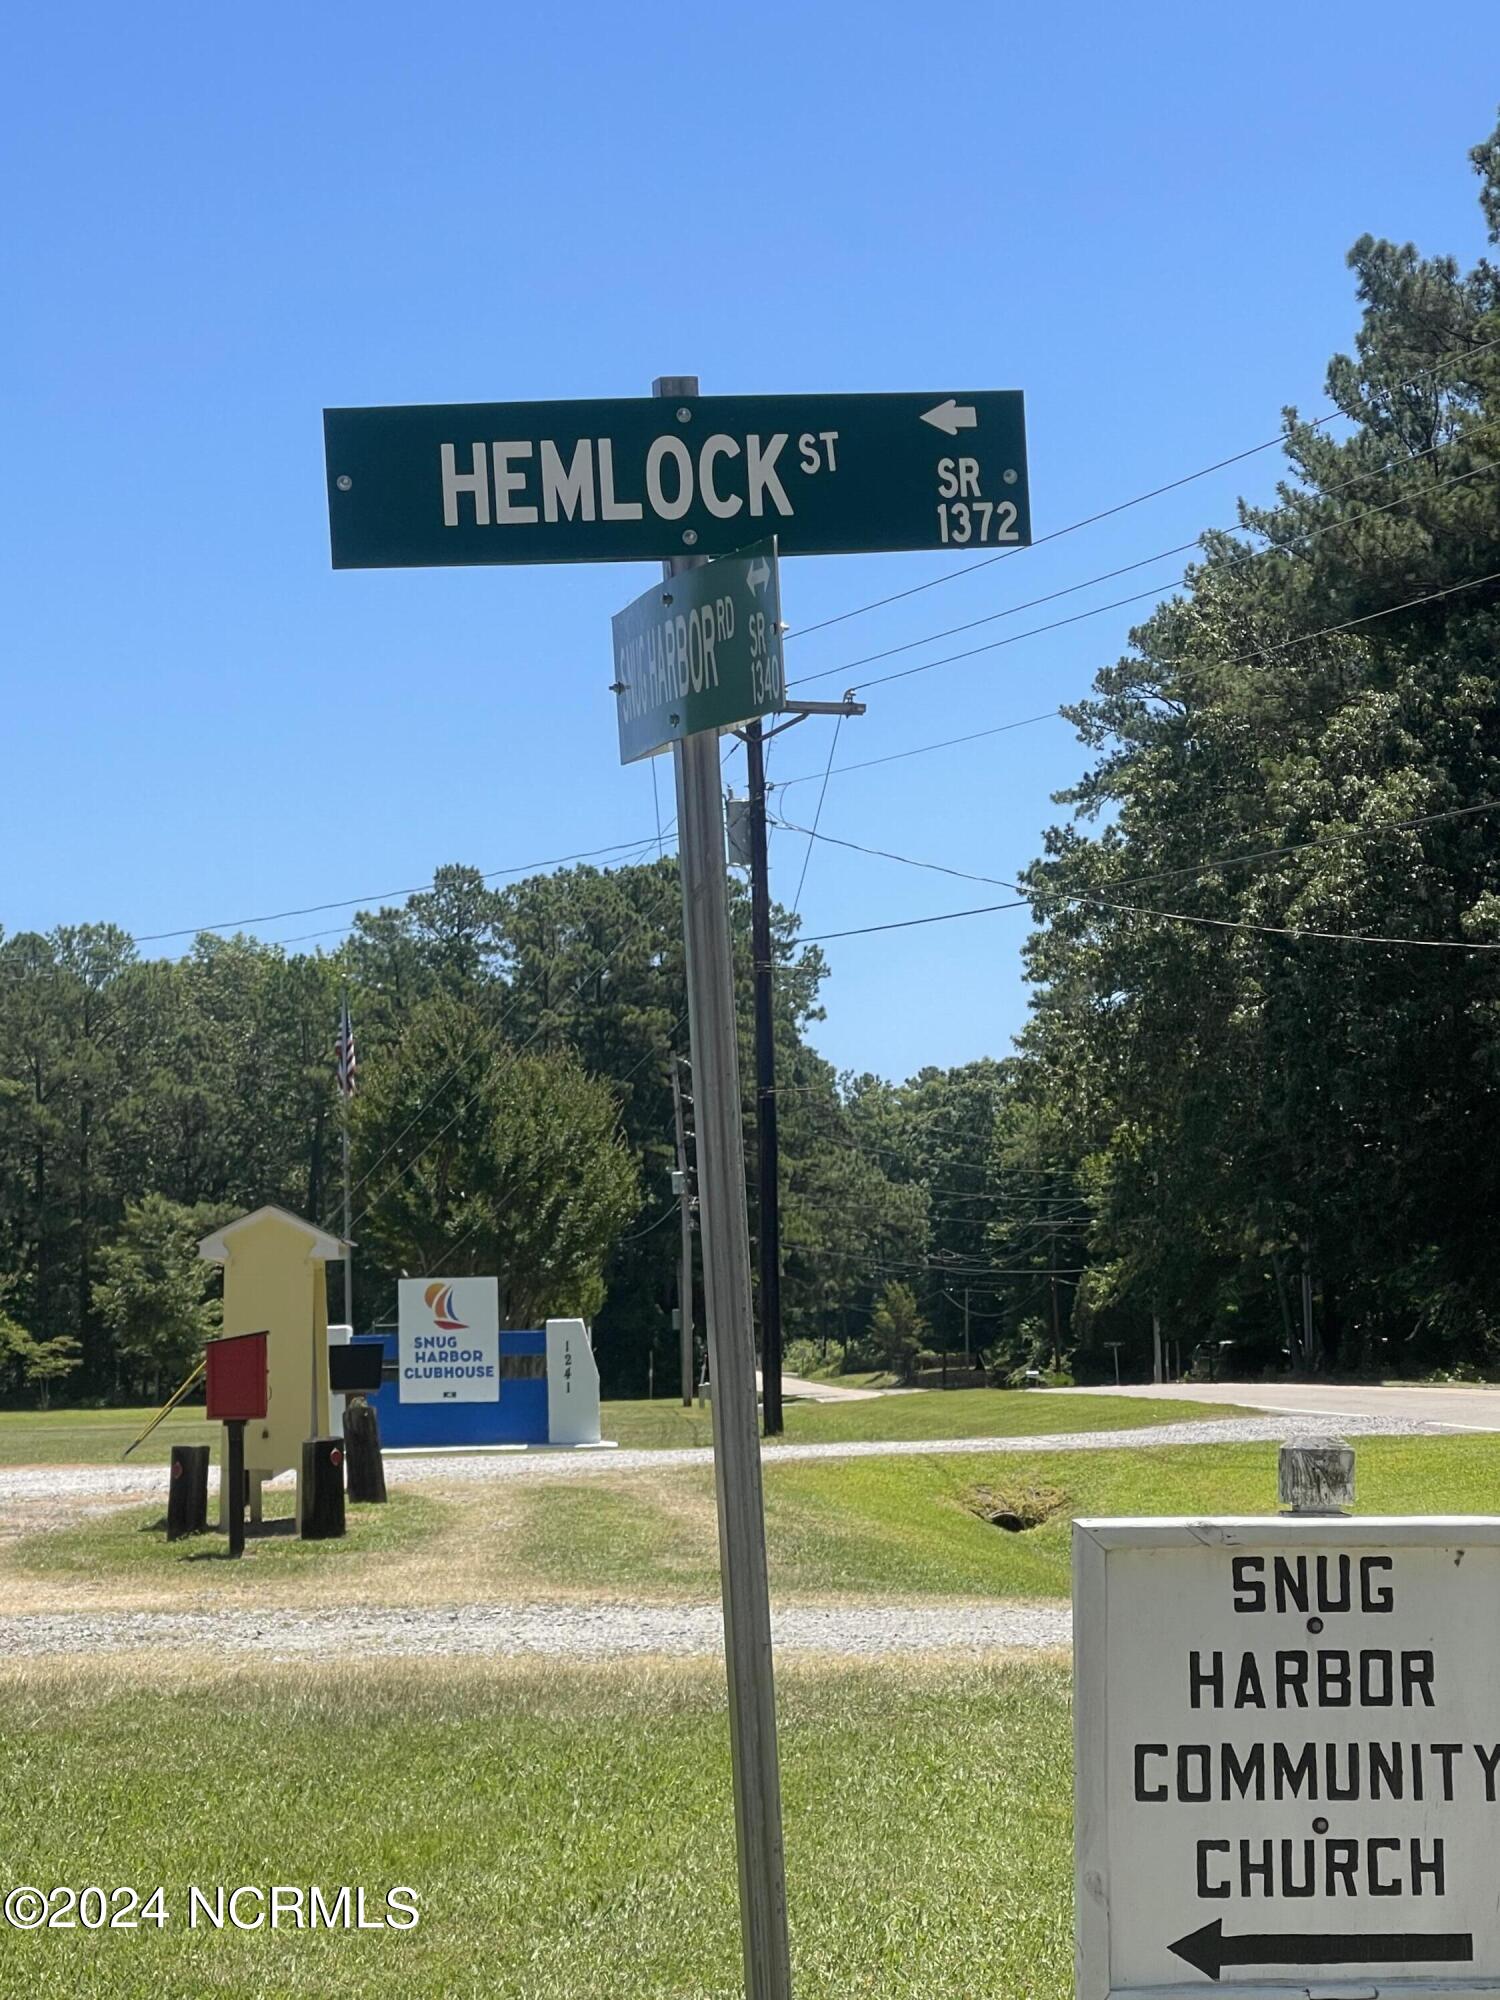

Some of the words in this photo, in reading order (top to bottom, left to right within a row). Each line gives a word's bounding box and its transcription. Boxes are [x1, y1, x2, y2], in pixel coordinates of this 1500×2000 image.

[440, 433, 795, 527] HEMLOCK
[799, 431, 840, 475] ST
[937, 457, 982, 499] SR
[937, 500, 1020, 543] 1372
[647, 604, 720, 709] HARBOR
[716, 595, 735, 642] RD
[749, 611, 767, 657] SR
[751, 655, 780, 705] 1340
[414, 1336, 457, 1349] SNUG
[415, 1350, 483, 1363] HARBOR
[563, 1340, 572, 1394] 1241
[404, 1366, 494, 1379] CLUBHOUSE
[1232, 1555, 1394, 1613] SNUG
[1189, 1649, 1436, 1709] HARBOR
[1134, 1742, 1500, 1802] COMMUNITY
[1196, 1837, 1445, 1898] CHURCH
